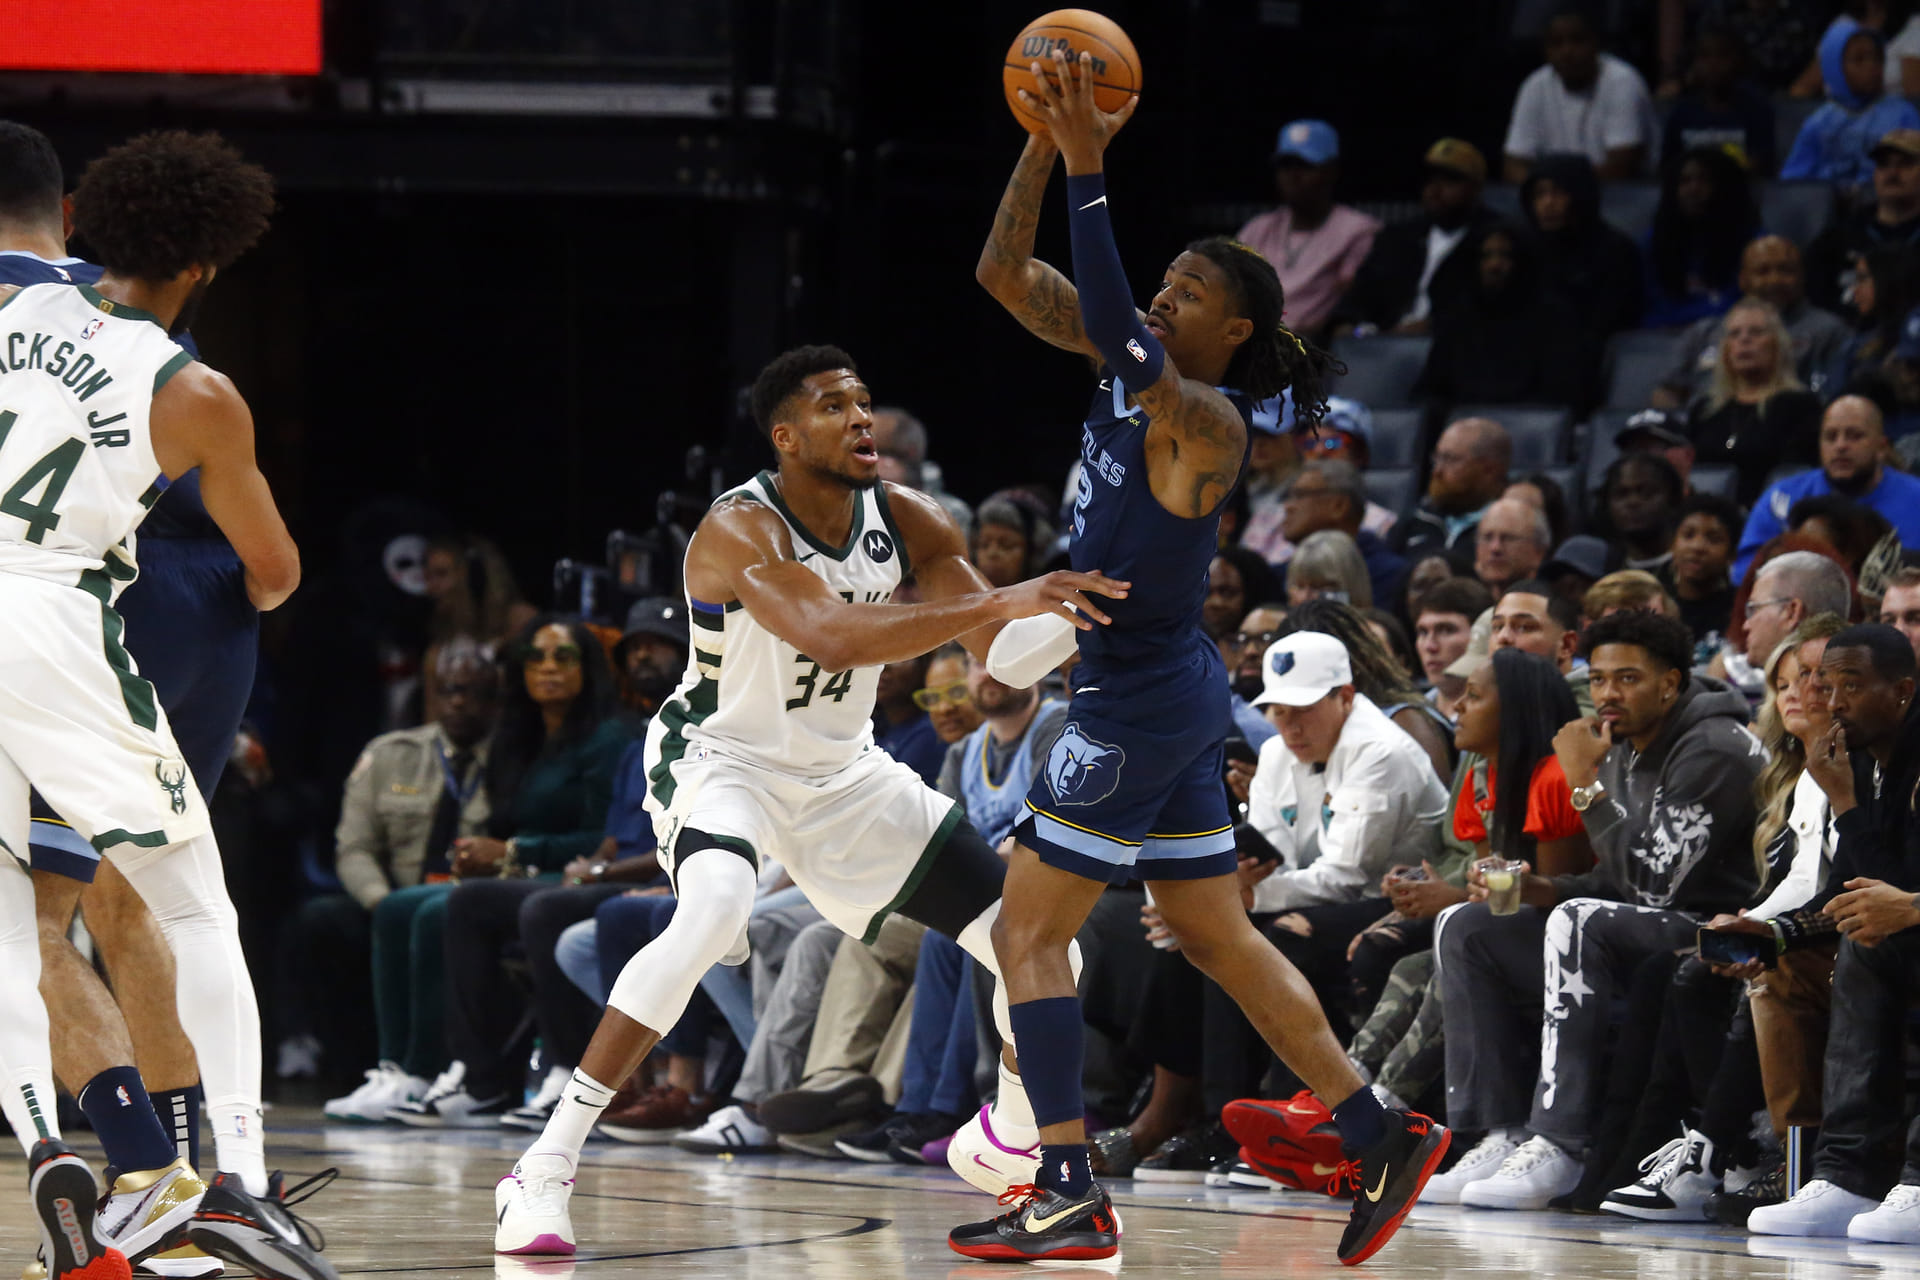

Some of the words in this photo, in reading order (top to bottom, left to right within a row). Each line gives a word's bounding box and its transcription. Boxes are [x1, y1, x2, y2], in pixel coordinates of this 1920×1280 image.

[1022, 36, 1107, 76] Wilsn
[87, 410, 131, 448] JR
[785, 653, 854, 712] 34
